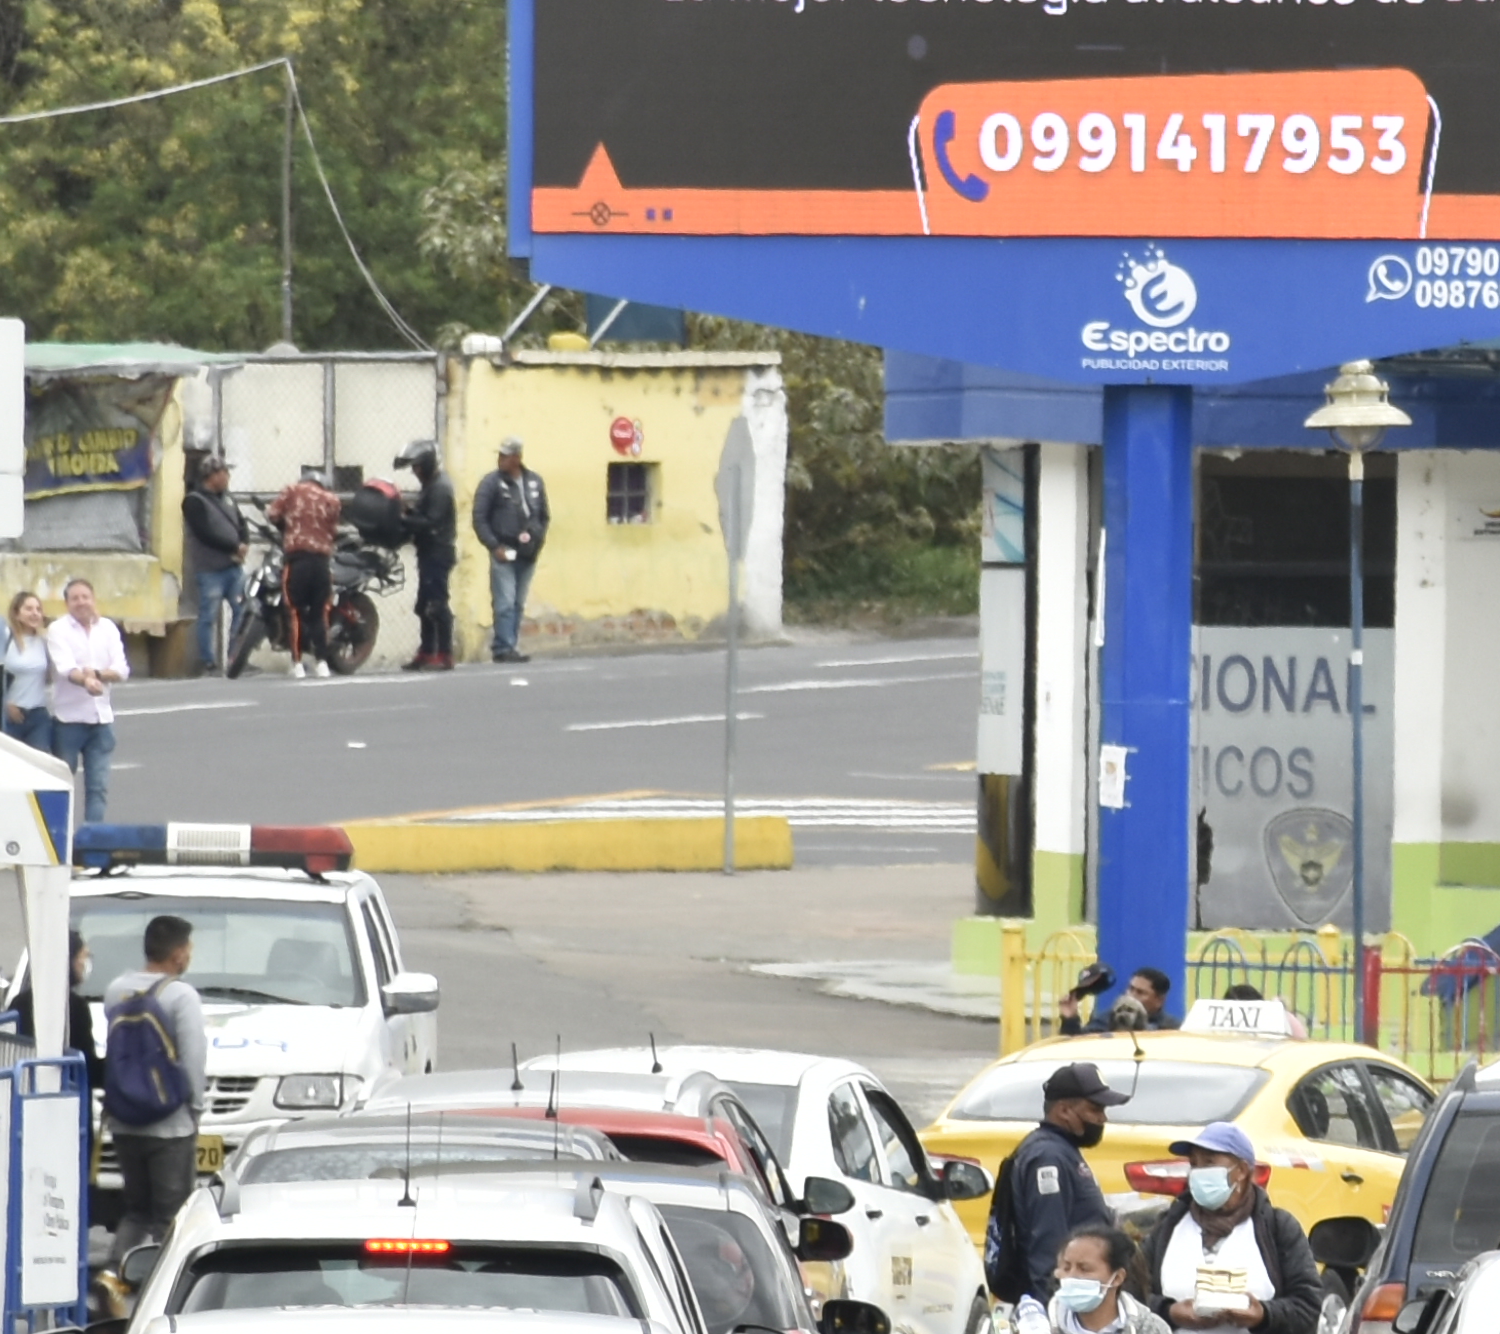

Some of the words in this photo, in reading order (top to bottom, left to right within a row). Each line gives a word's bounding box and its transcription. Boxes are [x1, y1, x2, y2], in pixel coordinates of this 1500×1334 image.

[977, 111, 1409, 176] 0991417953
[1080, 320, 1231, 358] Espectro
[1081, 357, 1160, 371] PUBLICIDAD
[1162, 358, 1230, 372] EXTERIOR
[1191, 653, 1377, 714] IONAL
[1191, 744, 1316, 800] ICOS
[1206, 1006, 1263, 1030] TAXI
